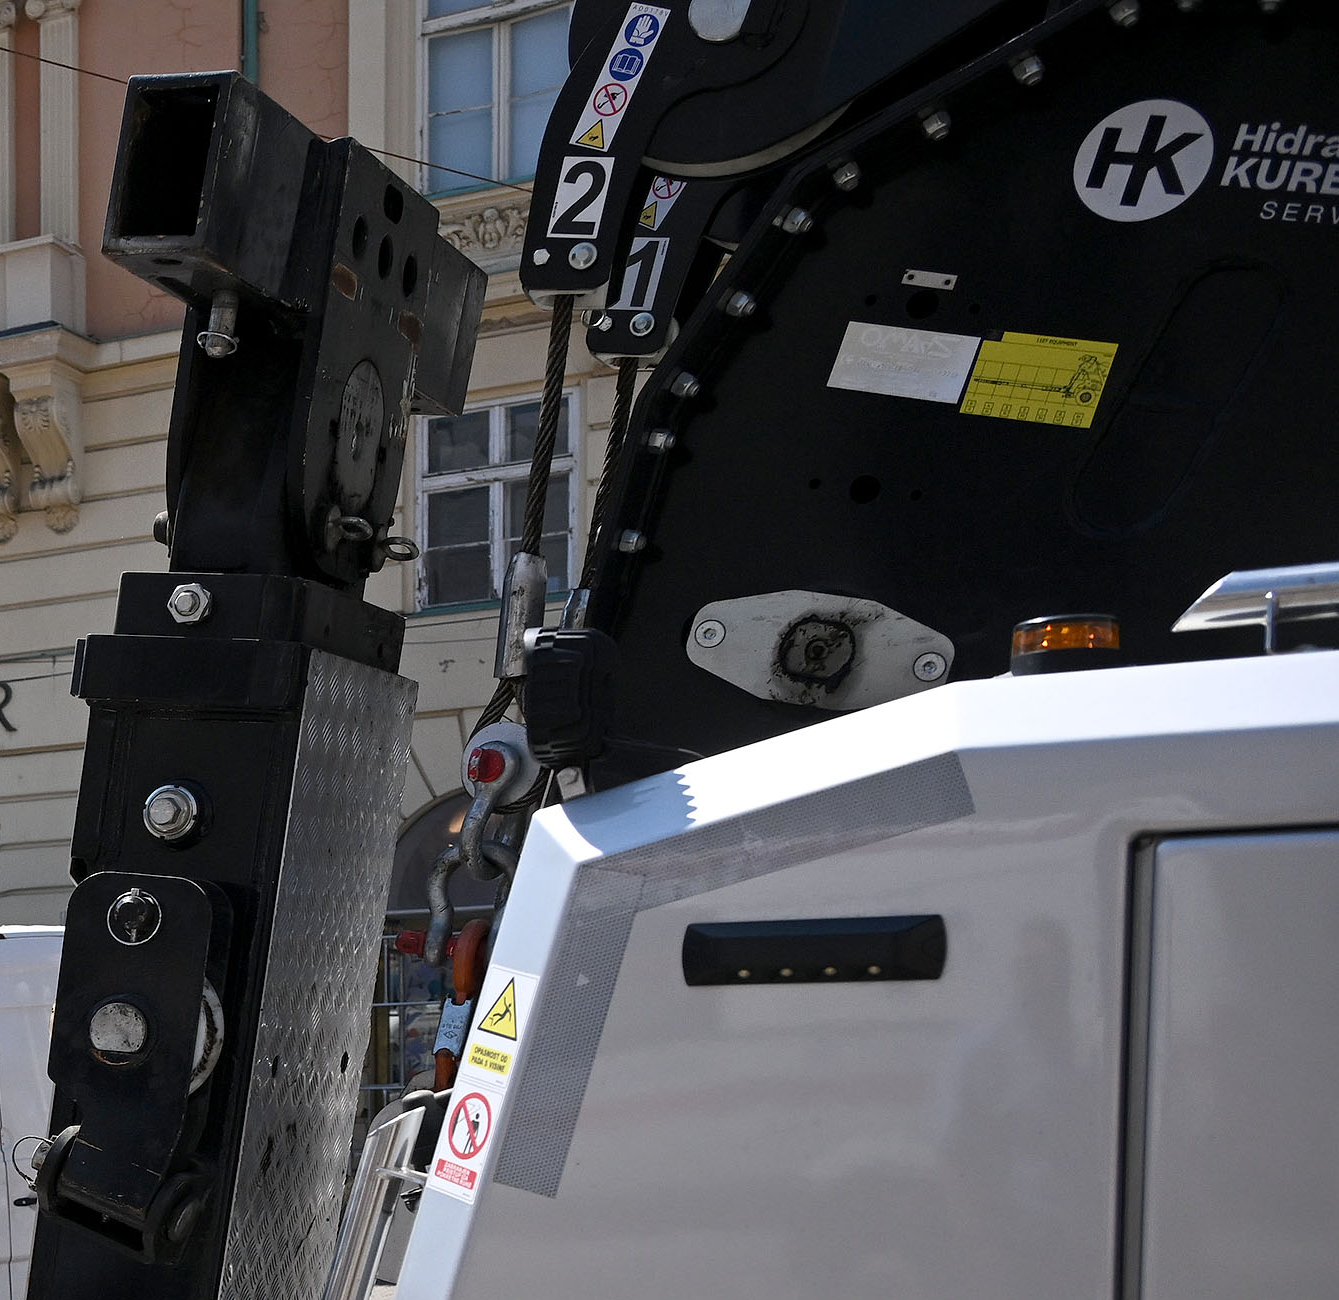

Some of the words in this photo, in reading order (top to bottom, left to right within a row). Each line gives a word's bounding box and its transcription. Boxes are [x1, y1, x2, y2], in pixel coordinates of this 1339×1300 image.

[1086, 115, 1204, 206] HK
[1232, 122, 1339, 158] Hidra
[550, 161, 606, 235] 2
[626, 241, 660, 307] 1
